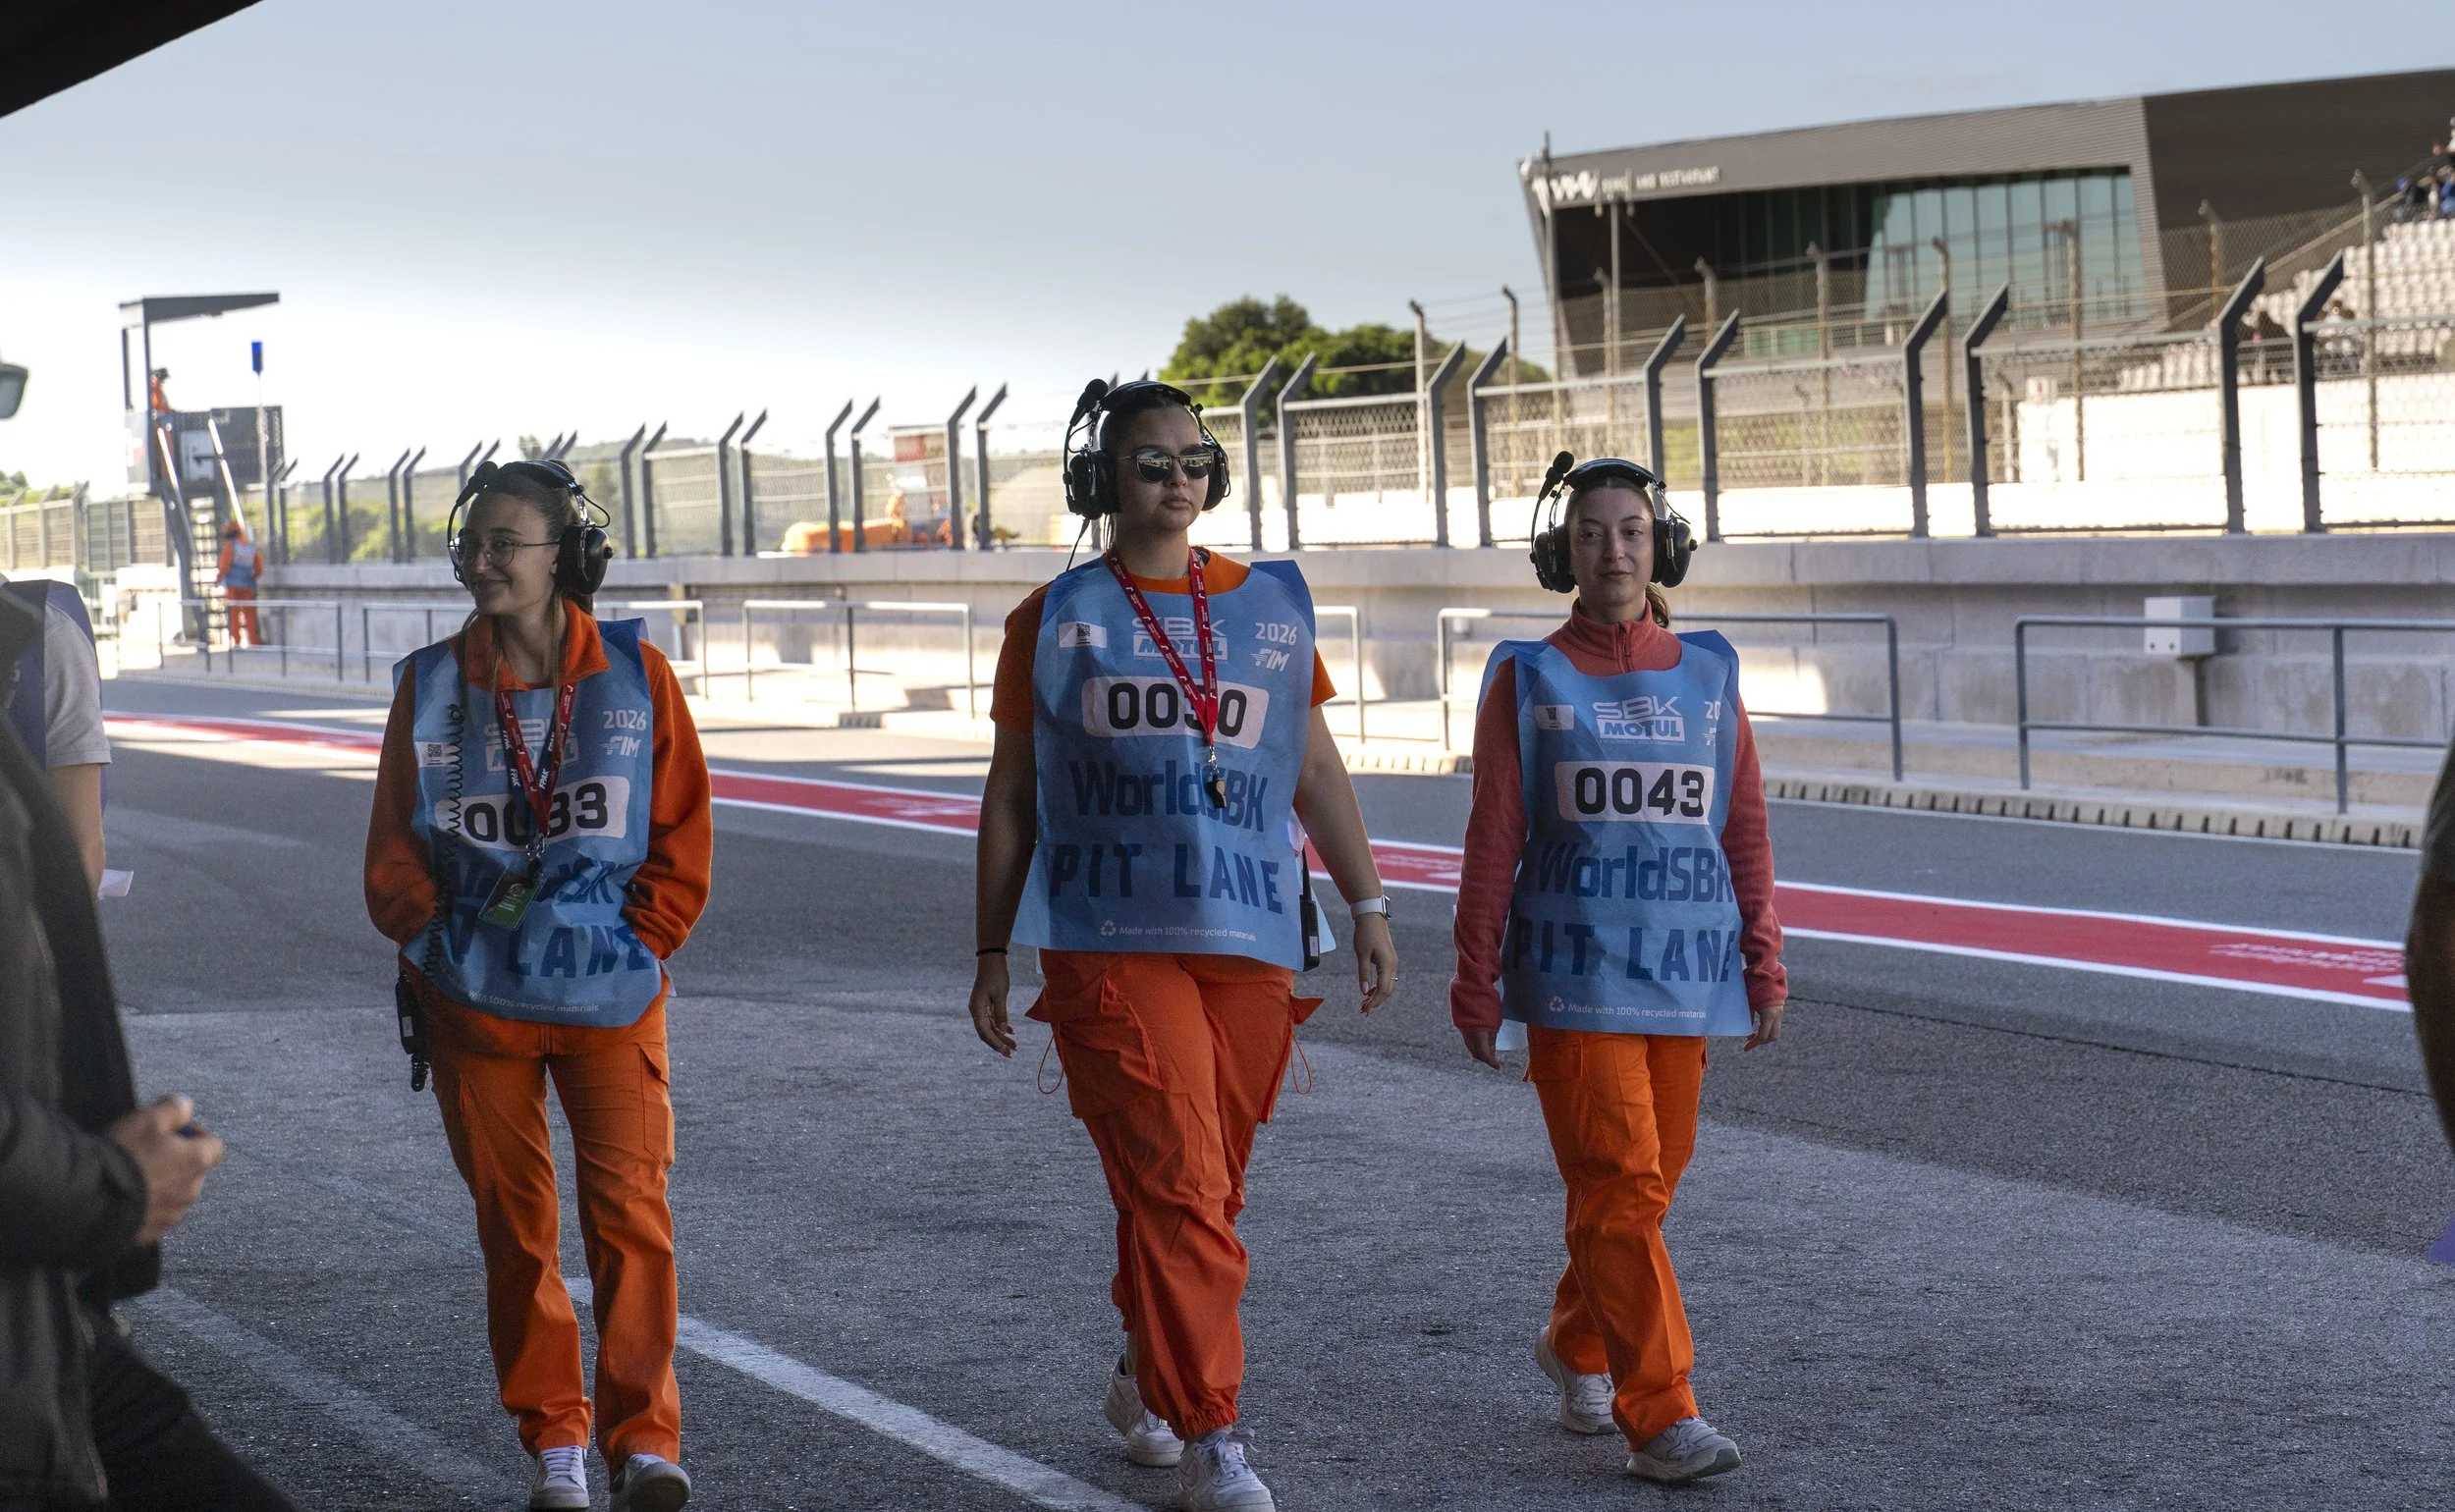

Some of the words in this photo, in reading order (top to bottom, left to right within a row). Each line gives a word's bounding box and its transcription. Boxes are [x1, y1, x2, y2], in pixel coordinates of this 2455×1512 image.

[1255, 622, 1297, 646] 2026
[1250, 648, 1290, 672] FIM
[1592, 695, 1682, 719] SBK
[603, 709, 647, 731] 2026
[1603, 717, 1681, 737] MOTUL
[600, 735, 642, 758] FIM
[510, 768, 521, 787] FPAK
[538, 768, 550, 790] FPAK
[1068, 760, 1269, 833] WorldSBK
[1575, 768, 1705, 818] 0043
[1050, 843, 1142, 897] PIT
[1173, 843, 1283, 915] LANE
[1119, 926, 1142, 936] Made
[1145, 926, 1163, 936] with
[1165, 926, 1188, 936] 100%
[1190, 927, 1227, 938] recycled
[1228, 930, 1257, 942] materials
[1513, 916, 1596, 976] PIT
[1626, 927, 1736, 983] LANE
[1568, 1003, 1593, 1013] Made
[1595, 1004, 1613, 1015] with
[1615, 1006, 1640, 1016] 100%
[1641, 1007, 1677, 1019] recycled
